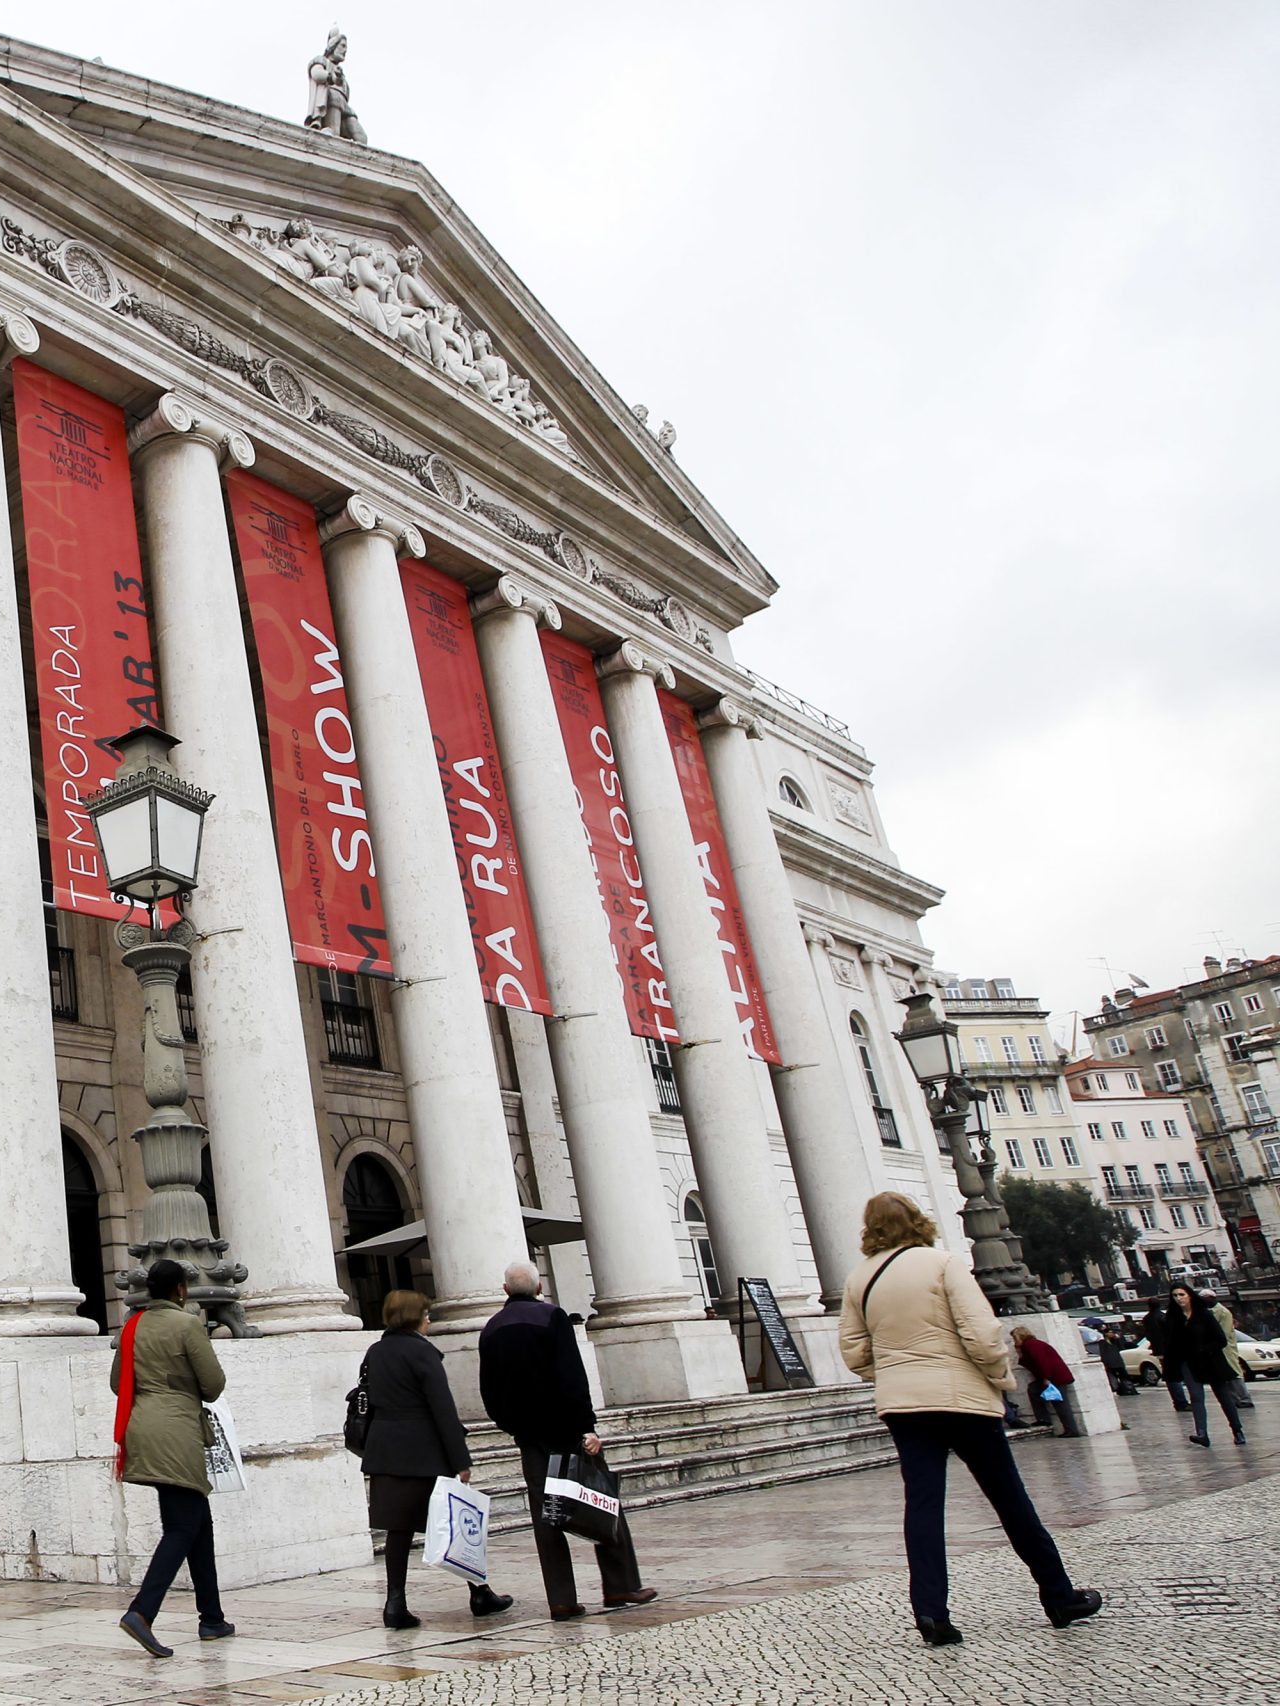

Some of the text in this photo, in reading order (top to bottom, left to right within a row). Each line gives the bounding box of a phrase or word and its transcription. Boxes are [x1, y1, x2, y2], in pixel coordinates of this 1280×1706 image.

[48, 450, 104, 484] NACIONAL
[54, 441, 97, 469] TEATRO
[48, 624, 100, 908] TEMPORADA
[291, 727, 306, 783] CARLO
[475, 692, 519, 876] DE NUNO COSTA SANTOS
[299, 787, 310, 817] DEL
[452, 756, 509, 896] RUA
[303, 821, 332, 946] MARCANTONIO
[590, 725, 680, 1042] TRANCOSO
[485, 926, 534, 1013] DA
[578, 1487, 589, 1502] In
